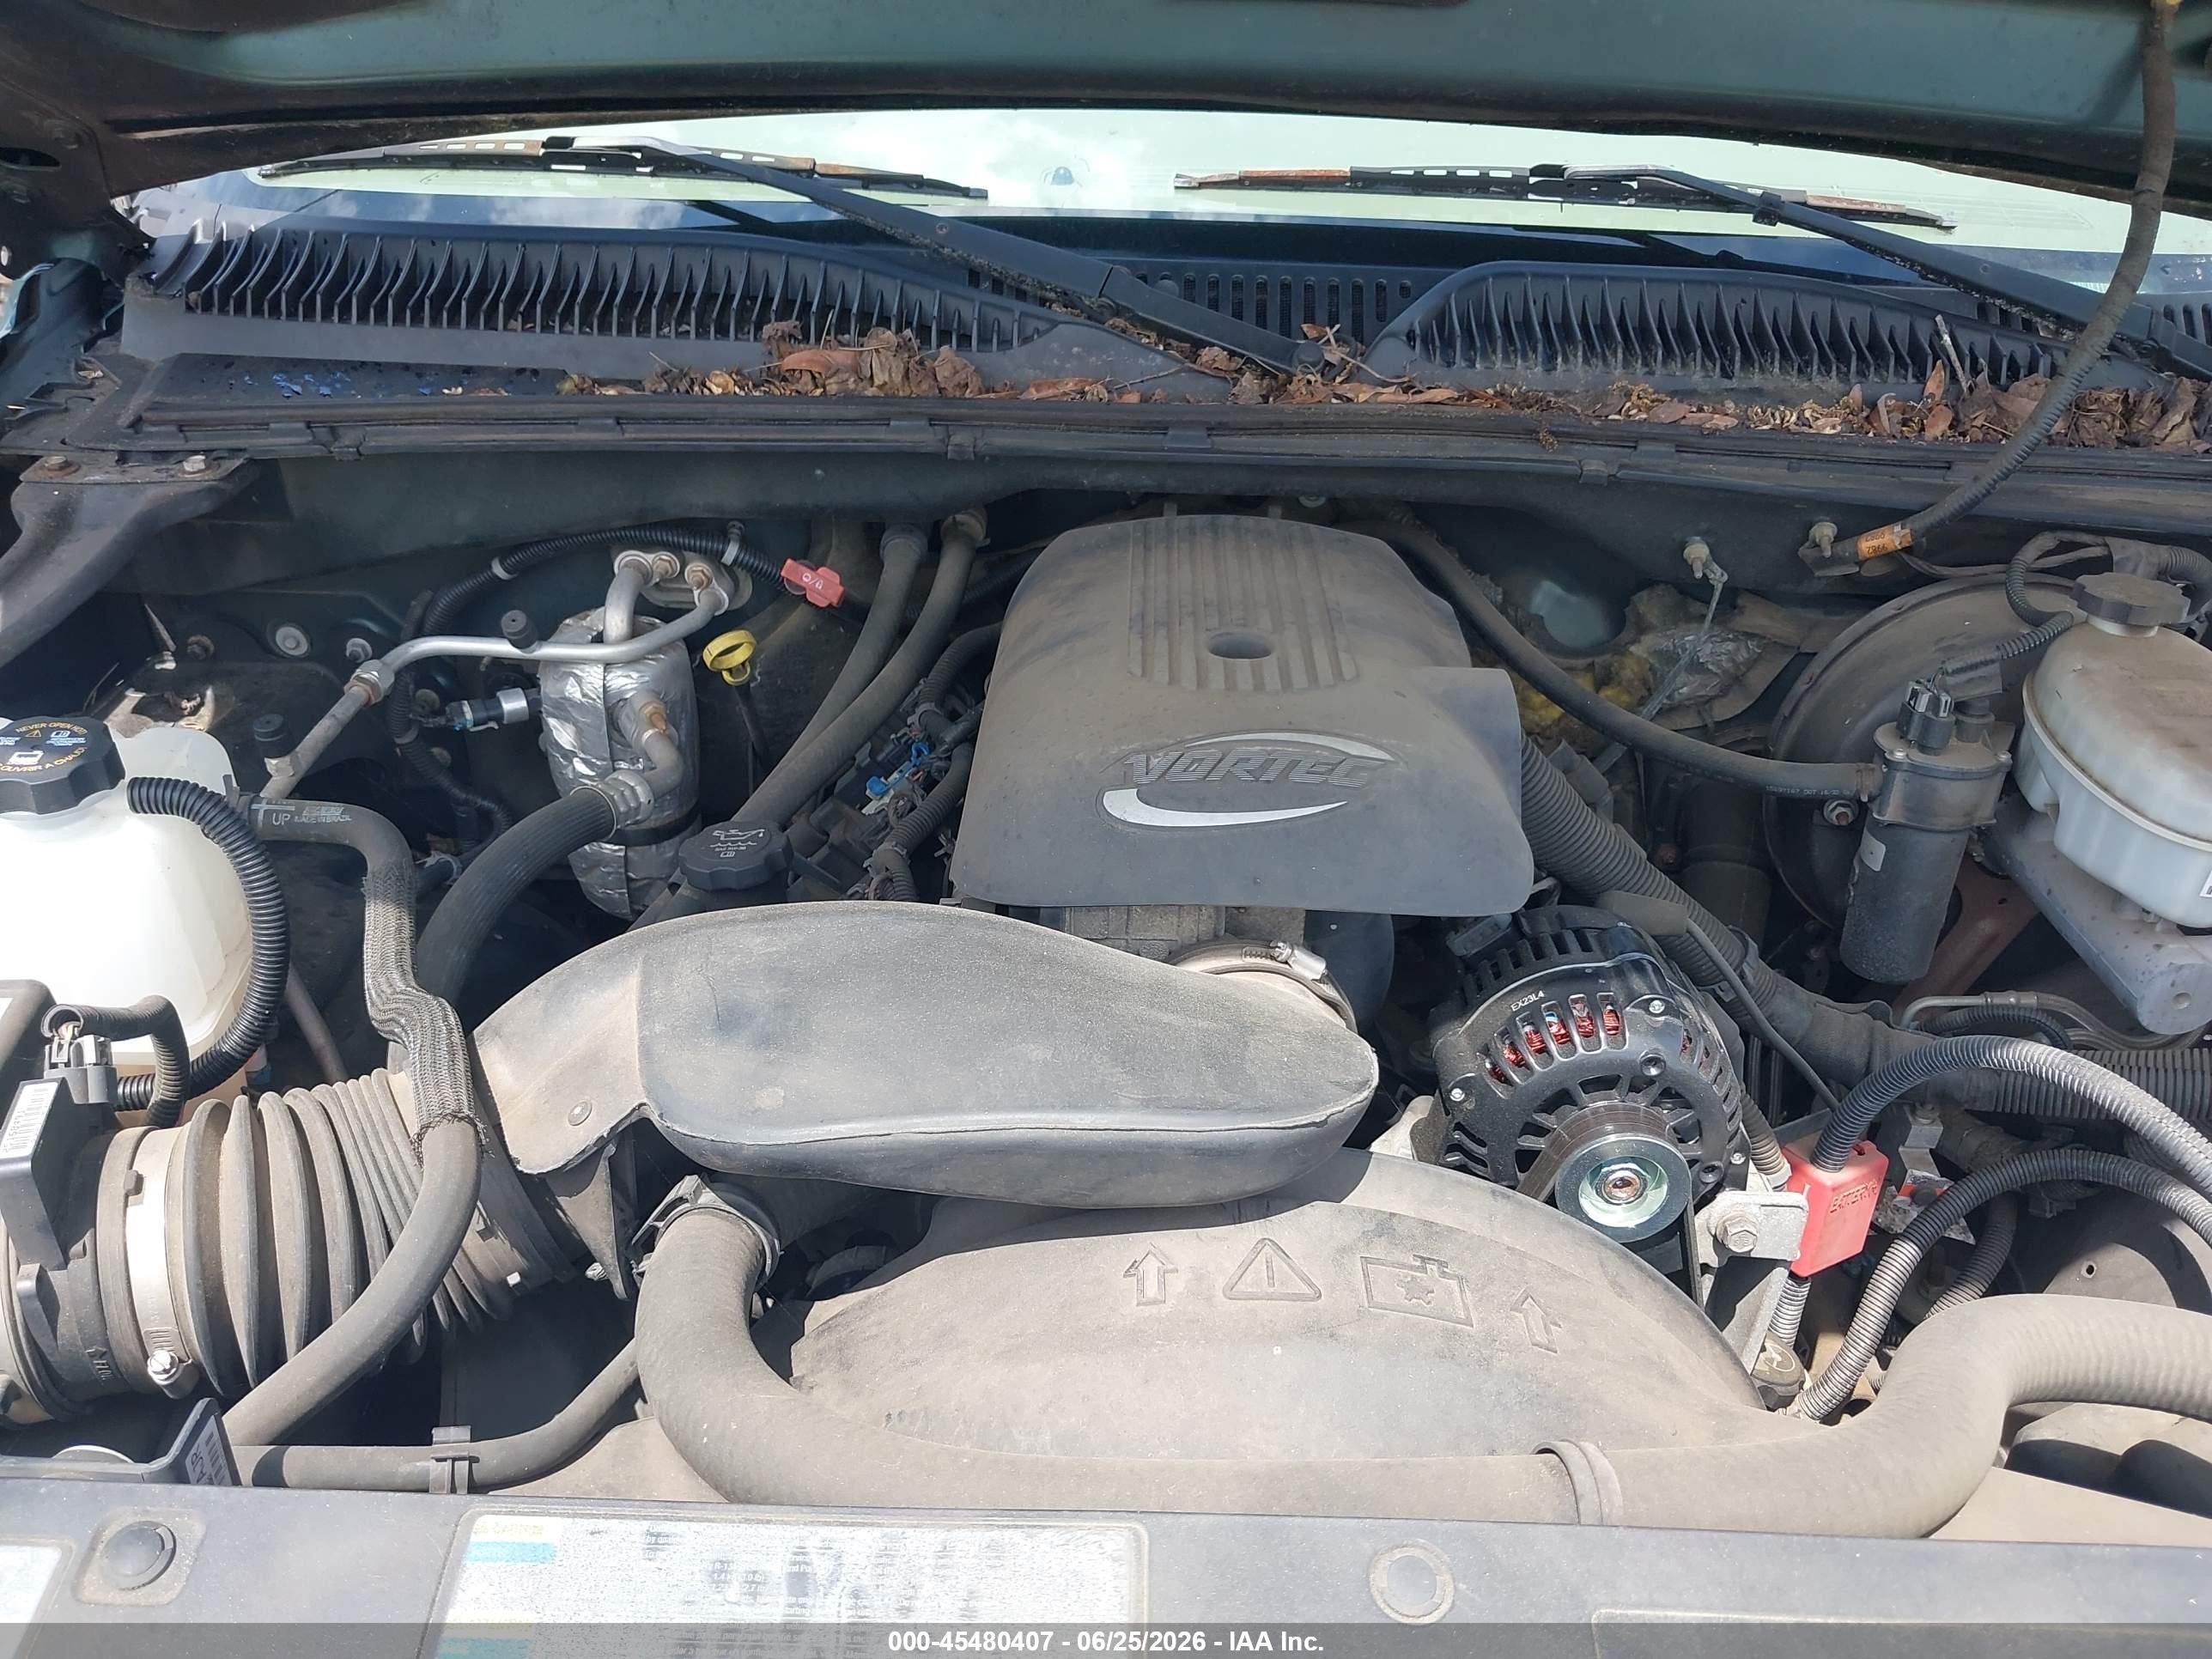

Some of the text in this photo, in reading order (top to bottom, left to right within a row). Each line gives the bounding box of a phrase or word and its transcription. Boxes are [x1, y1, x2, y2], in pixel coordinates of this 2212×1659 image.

[15, 721, 48, 733] NEVER
[48, 721, 73, 730] OPEN
[1123, 749, 1385, 789] VORTEC
[272, 812, 291, 825] UP
